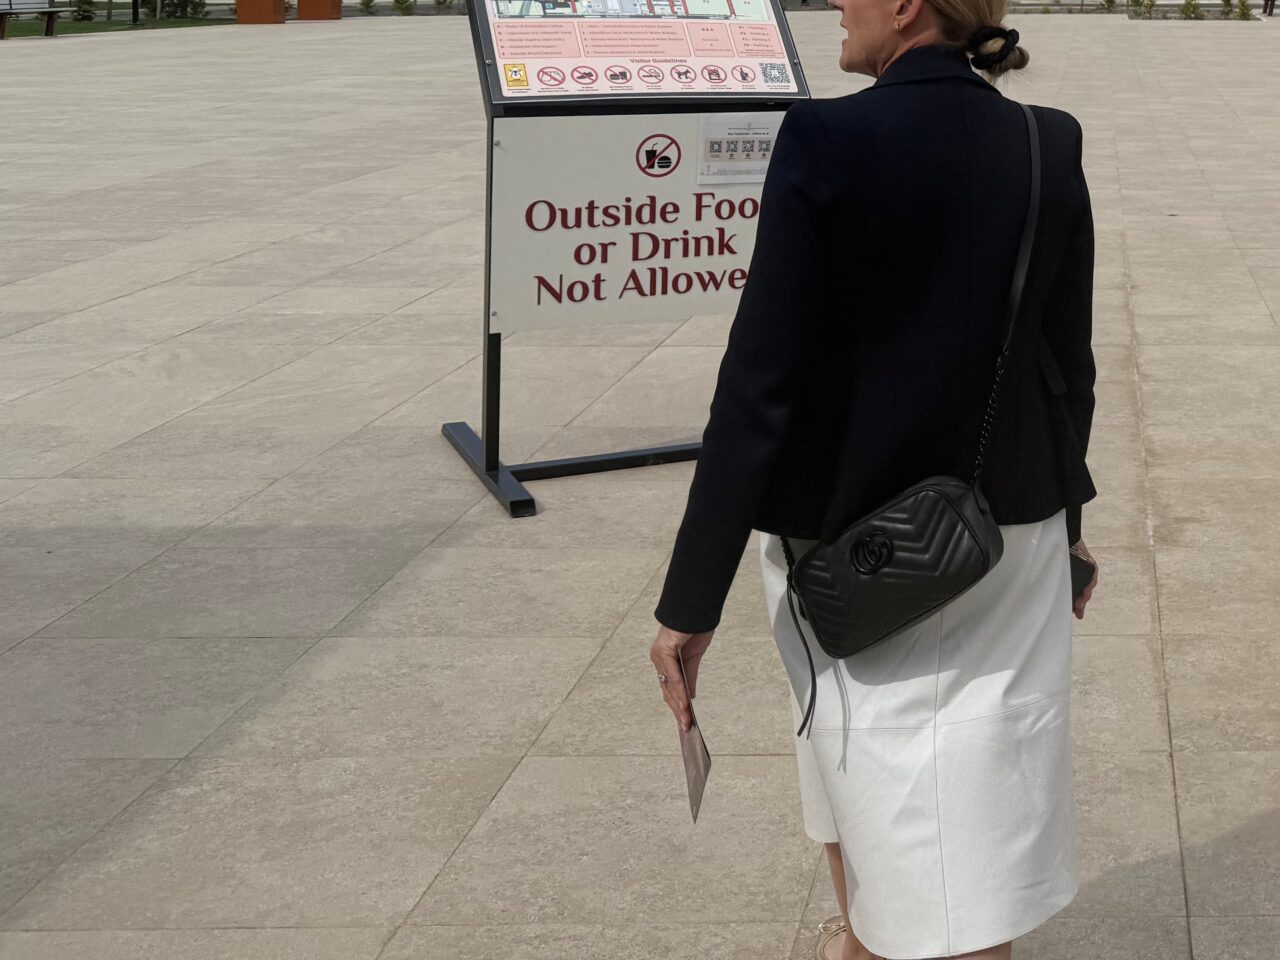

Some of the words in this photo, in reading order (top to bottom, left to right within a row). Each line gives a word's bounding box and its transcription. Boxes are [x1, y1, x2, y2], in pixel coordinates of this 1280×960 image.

[525, 195, 680, 232] Outside
[693, 192, 760, 221] Foo
[573, 240, 617, 265] or
[629, 227, 737, 262] Drink
[534, 272, 608, 306] Not
[619, 266, 750, 299] Allowe
